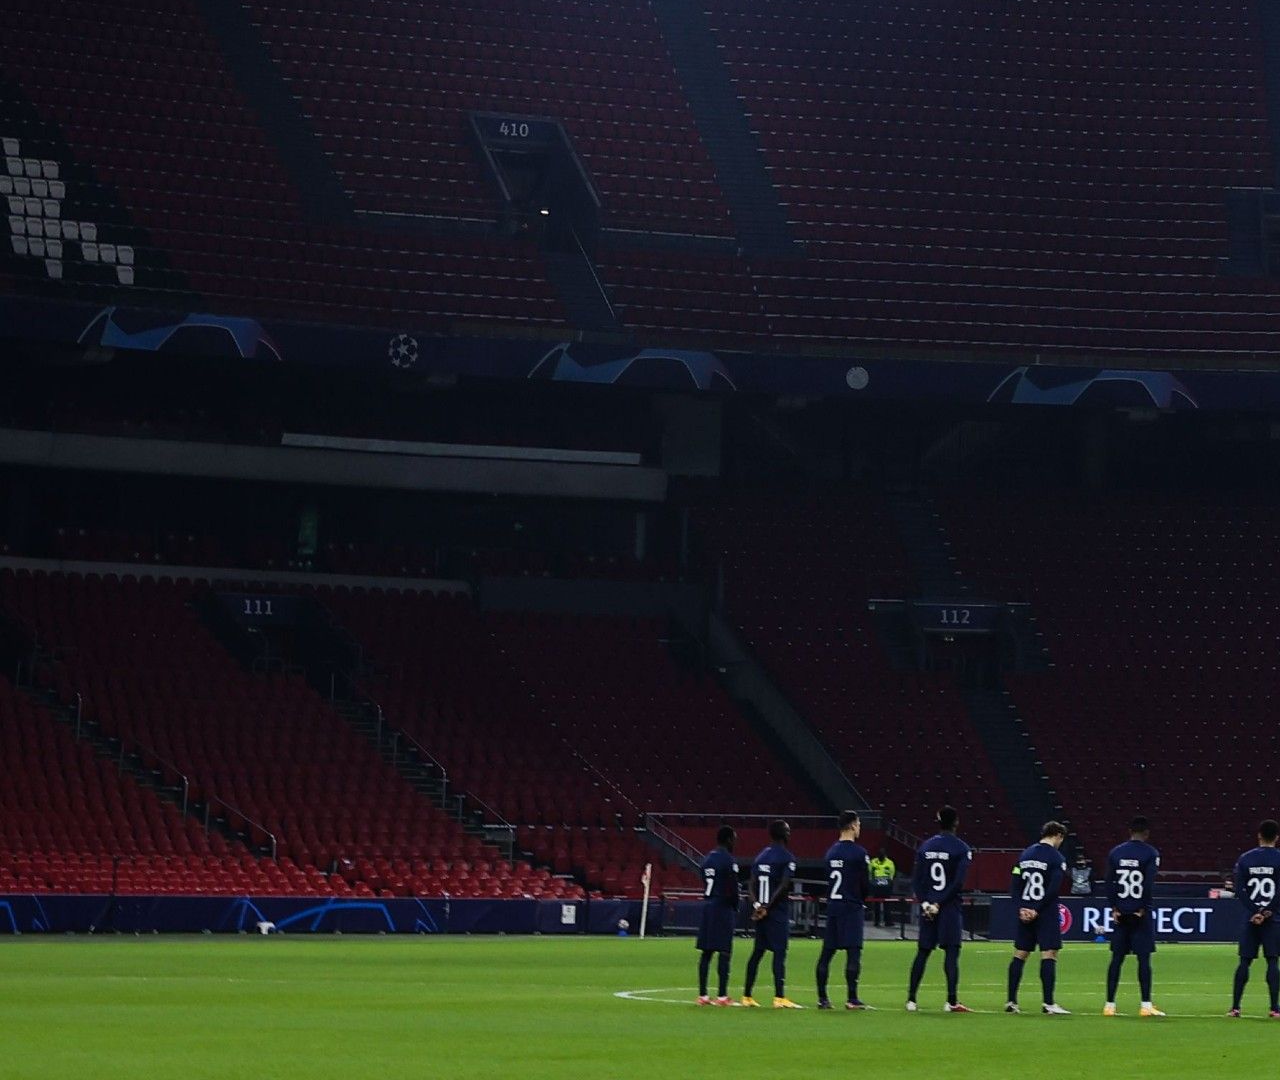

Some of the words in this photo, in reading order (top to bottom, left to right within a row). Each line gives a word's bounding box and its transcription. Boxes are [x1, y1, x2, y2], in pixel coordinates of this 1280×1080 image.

[498, 122, 529, 137] 410
[243, 600, 272, 615] 111
[941, 610, 970, 624] 112
[758, 876, 769, 904] 11
[829, 871, 843, 900] 2
[930, 862, 946, 891] 9
[1021, 871, 1045, 901] 28
[1115, 869, 1144, 899] 38
[1247, 877, 1276, 907] 29
[1082, 907, 1213, 933] REECT
